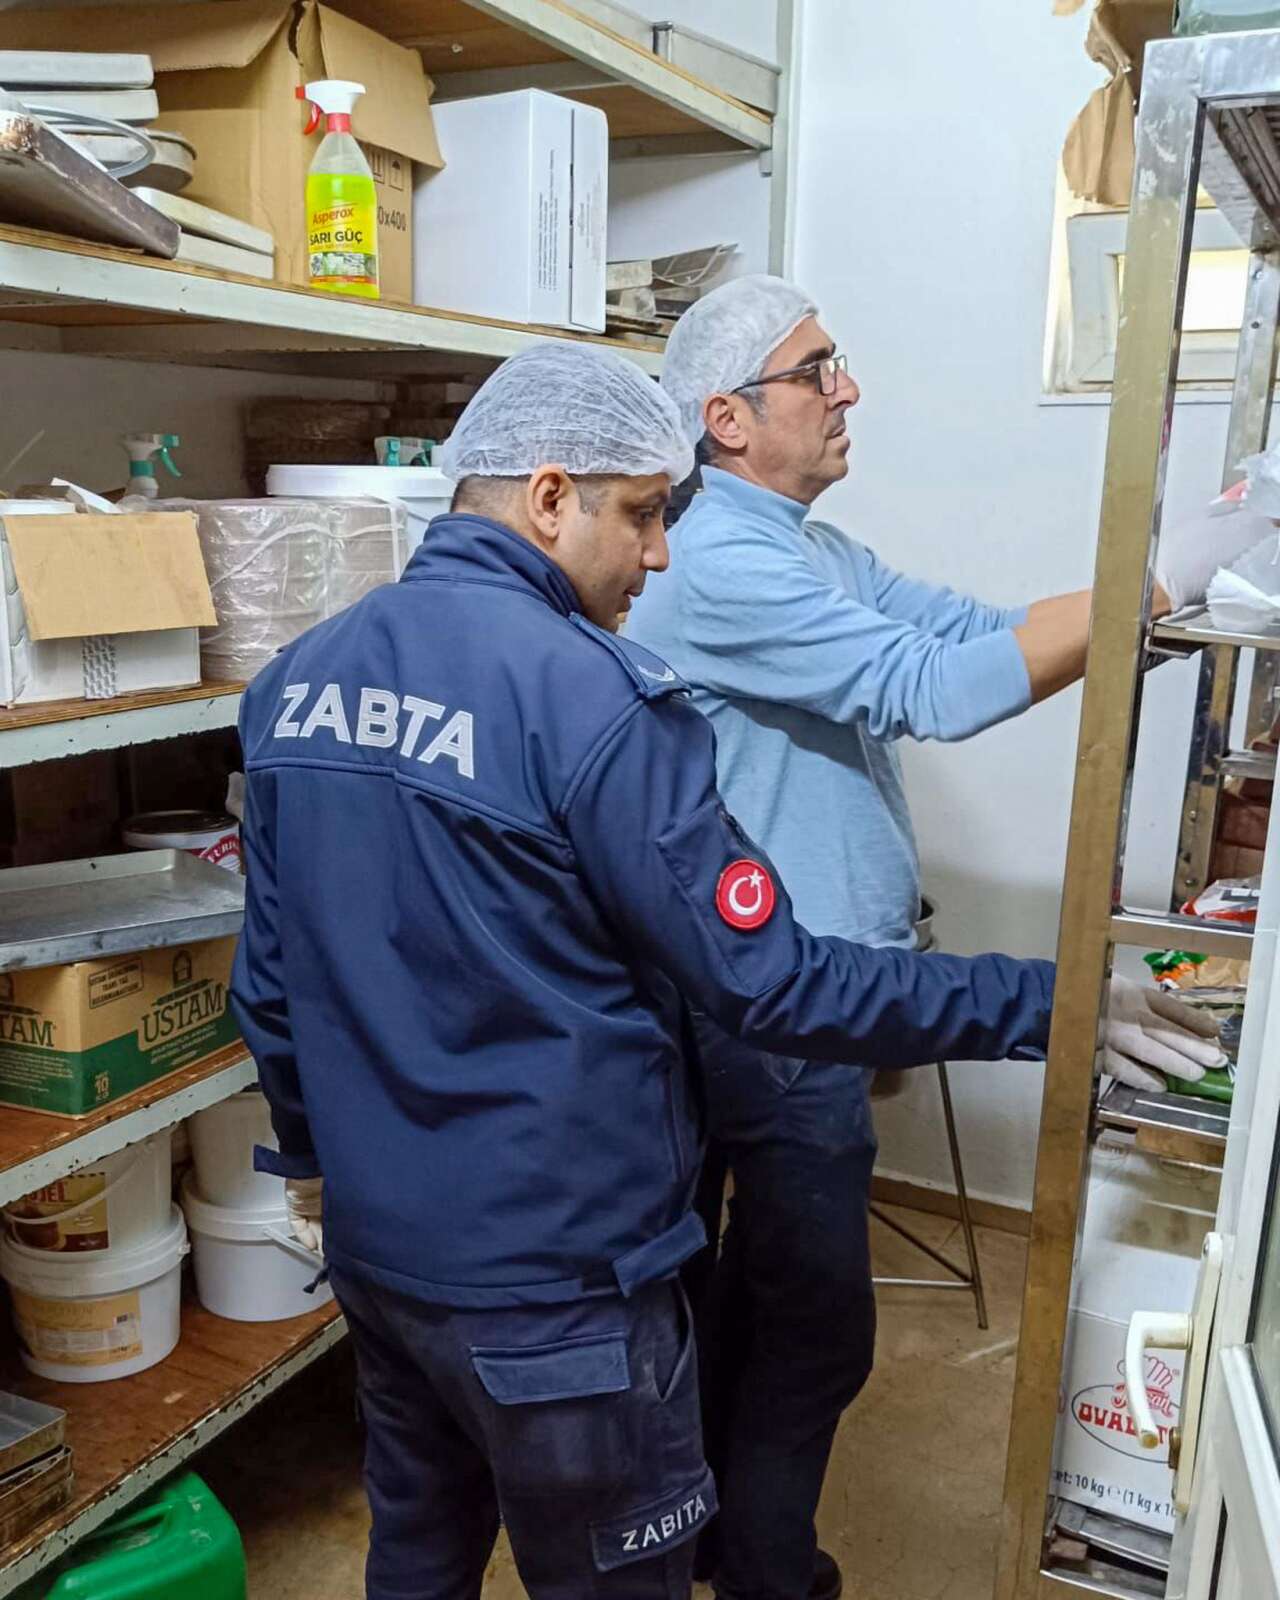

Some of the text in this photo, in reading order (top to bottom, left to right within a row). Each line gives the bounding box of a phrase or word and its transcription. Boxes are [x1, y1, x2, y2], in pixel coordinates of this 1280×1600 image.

[313, 207, 354, 224] Asperox
[335, 228, 363, 244] GÜÇ
[141, 981, 223, 1043] USTAM
[1076, 1475, 1089, 1490] 10
[1091, 1477, 1105, 1497] kg
[1137, 1493, 1151, 1514] kg
[1154, 1502, 1161, 1514] x
[622, 1494, 706, 1551] ZABITA
